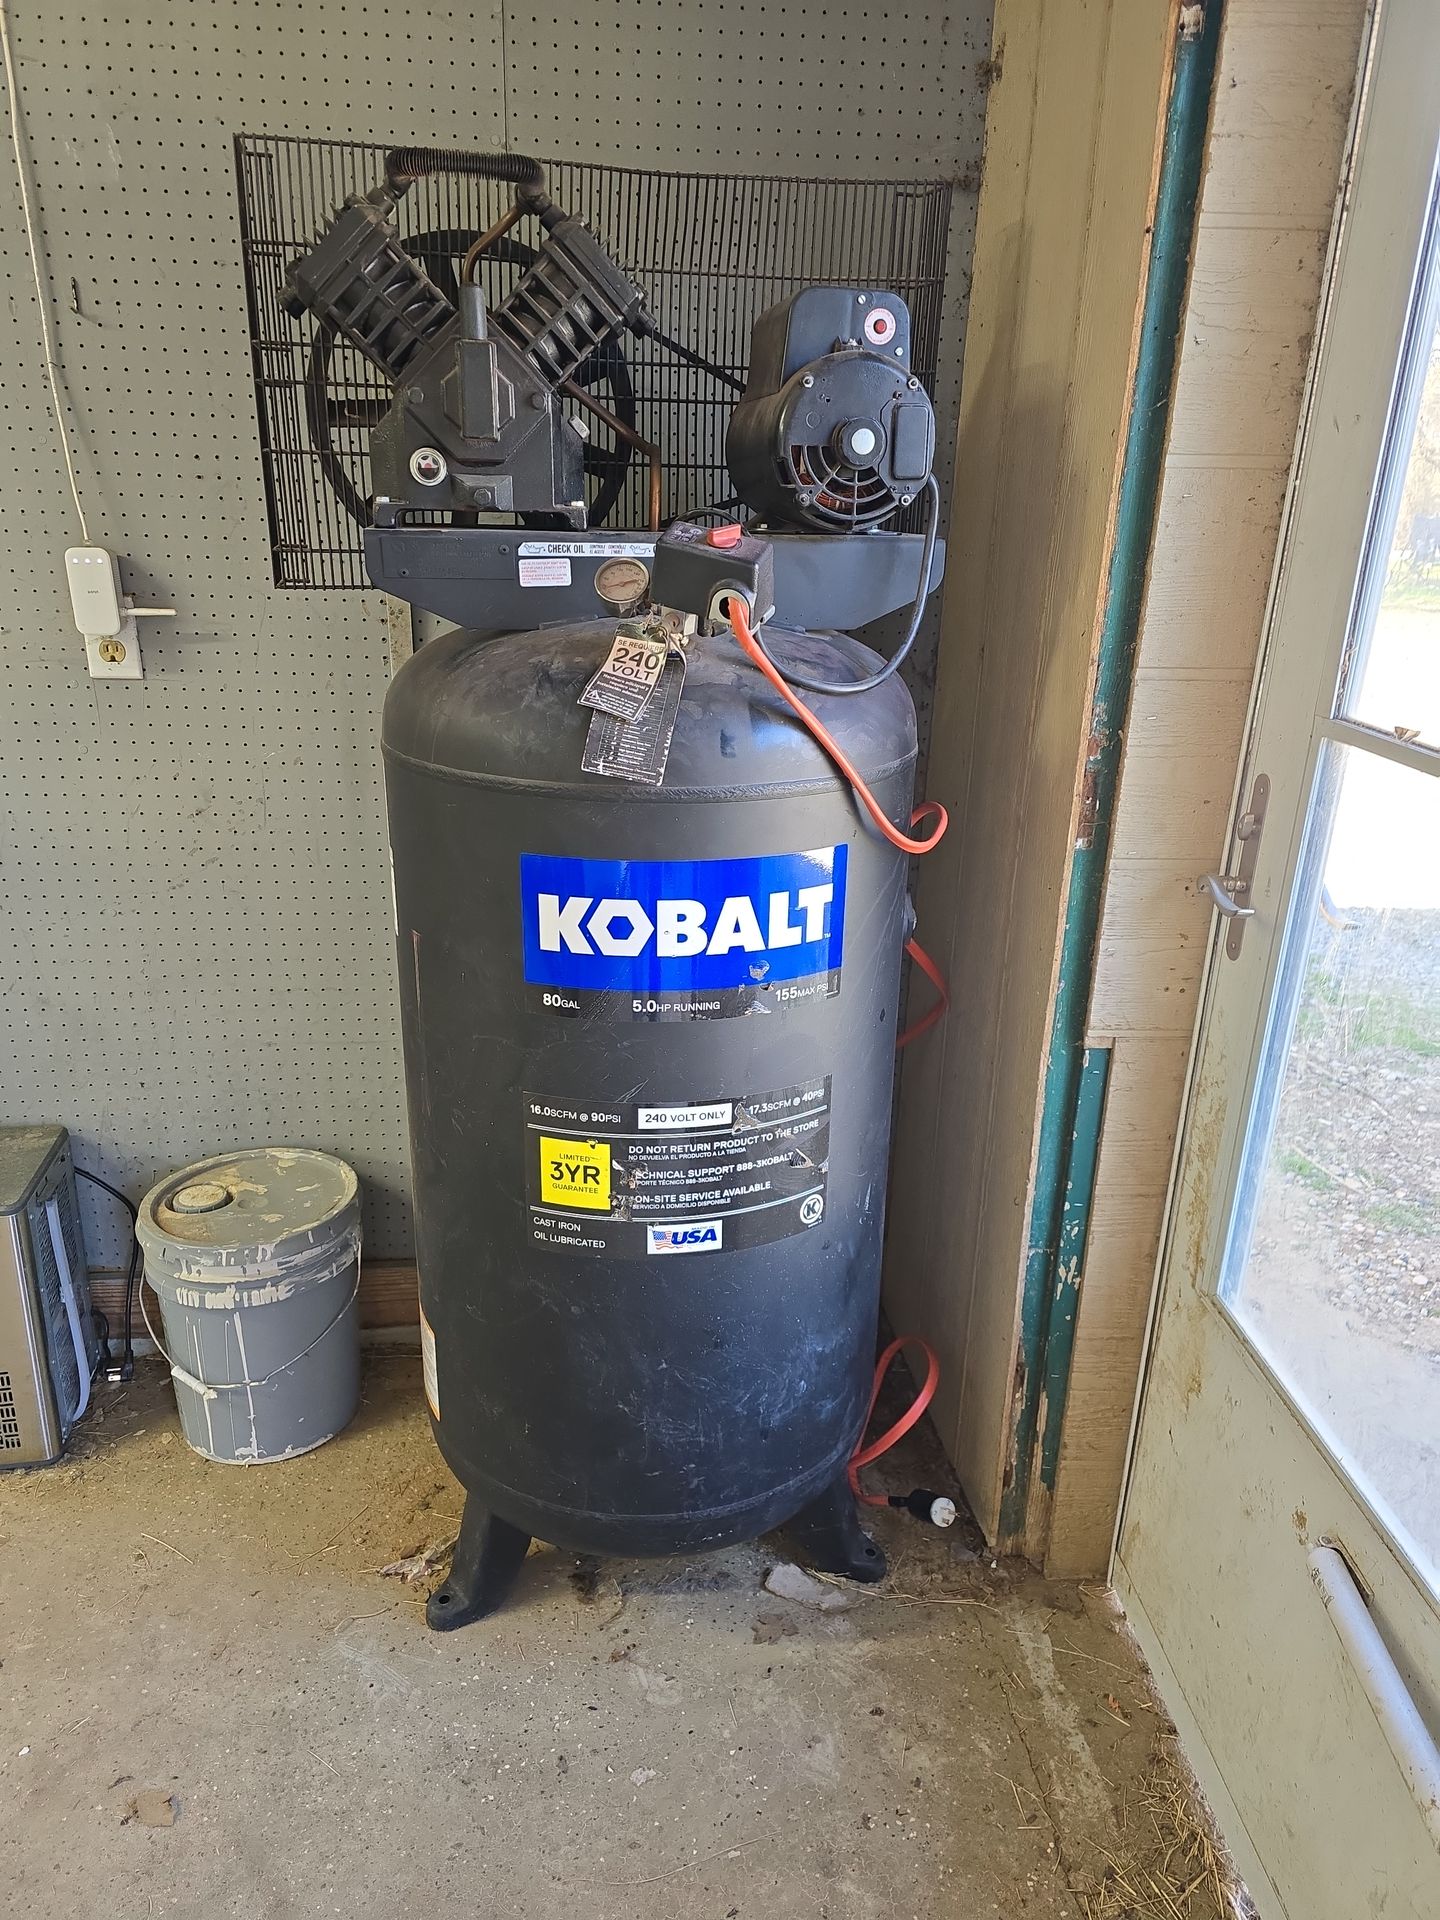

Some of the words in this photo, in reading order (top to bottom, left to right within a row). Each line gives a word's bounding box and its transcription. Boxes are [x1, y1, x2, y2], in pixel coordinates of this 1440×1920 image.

[547, 544, 572, 554] CHECK
[573, 544, 585, 554] OIL
[618, 639, 628, 647] SE
[613, 647, 660, 670] 240
[612, 663, 654, 681] VOLT
[538, 883, 834, 957] KOBALT
[542, 993, 581, 1009] 80GAL
[632, 999, 672, 1013] 5.0HP
[673, 1001, 721, 1012] RUNNING
[816, 982, 829, 994] PSI
[749, 1099, 792, 1115] 17.3SCFM
[793, 1097, 801, 1106] @
[802, 1088, 825, 1102] 40PSI
[530, 1104, 577, 1120] 16.0SCFM
[579, 1113, 589, 1122] @
[591, 1112, 621, 1123] 90PSI
[645, 1113, 667, 1123] 240
[670, 1113, 697, 1122] VOLT
[699, 1110, 726, 1121] ONLY
[628, 1146, 643, 1154] DO
[646, 1145, 667, 1154] NOT
[670, 1143, 711, 1153] RETURN
[713, 1136, 759, 1148] PRODUCT
[761, 1132, 773, 1142] TO
[775, 1129, 792, 1139] THE
[792, 1119, 819, 1134] STORE
[559, 1153, 591, 1163] LIMITED
[679, 1152, 711, 1160] PRODUCTO
[726, 1147, 746, 1155] TIENDA
[550, 1161, 600, 1185] 3YR
[687, 1165, 735, 1178] SUPPORT
[736, 1152, 794, 1172] 888-3KOBALT
[552, 1182, 599, 1194] GUARANTEE
[635, 1195, 677, 1203] ON-SITE
[679, 1190, 721, 1202] SERVICE
[697, 1197, 731, 1207] DISPONIBLE
[533, 1216, 556, 1228] CAST
[558, 1221, 581, 1232] IRON
[533, 1231, 549, 1241] OIL
[549, 1234, 606, 1249] LUBRICATED
[671, 1229, 717, 1245] USA
